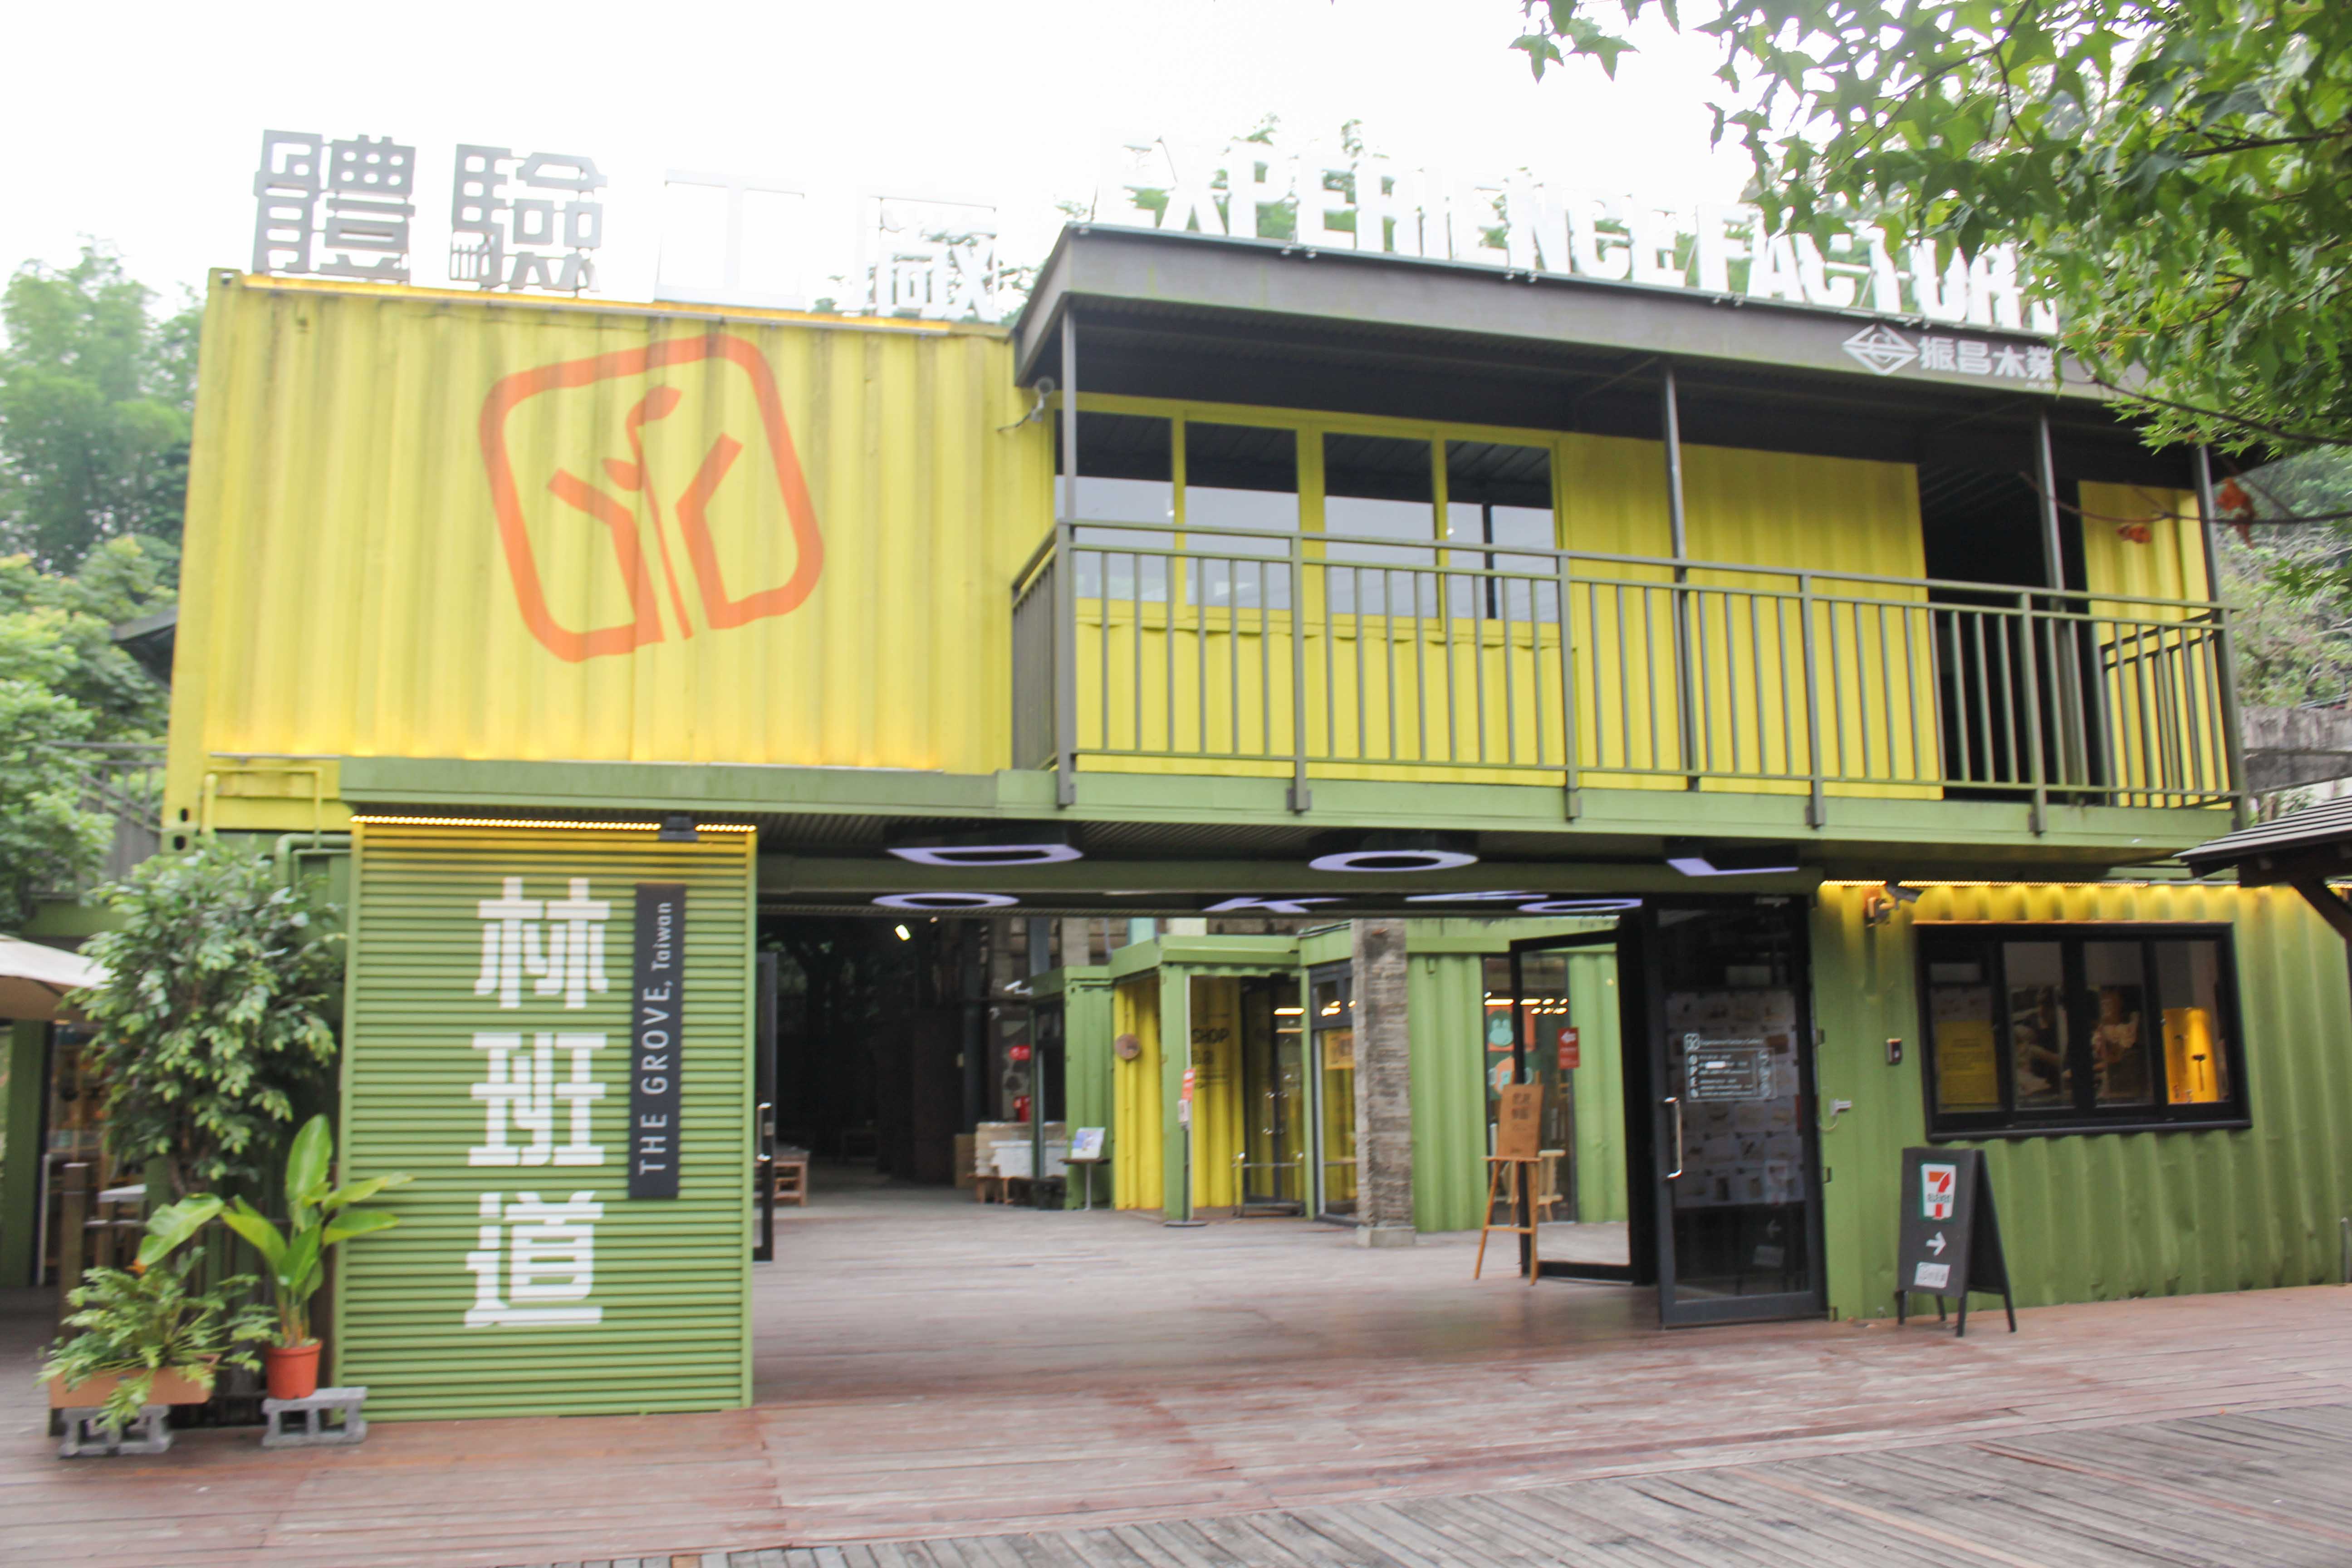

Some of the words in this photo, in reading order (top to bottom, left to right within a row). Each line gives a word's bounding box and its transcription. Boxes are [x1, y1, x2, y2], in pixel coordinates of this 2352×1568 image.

[1092, 127, 1687, 288] EXPERIENCE
[1918, 335, 2054, 381] 振昌木業
[650, 901, 672, 972] Taiwan
[640, 979, 674, 1095] GROVE,
[464, 877, 611, 1328] 林班道
[639, 1112, 669, 1176] THE
